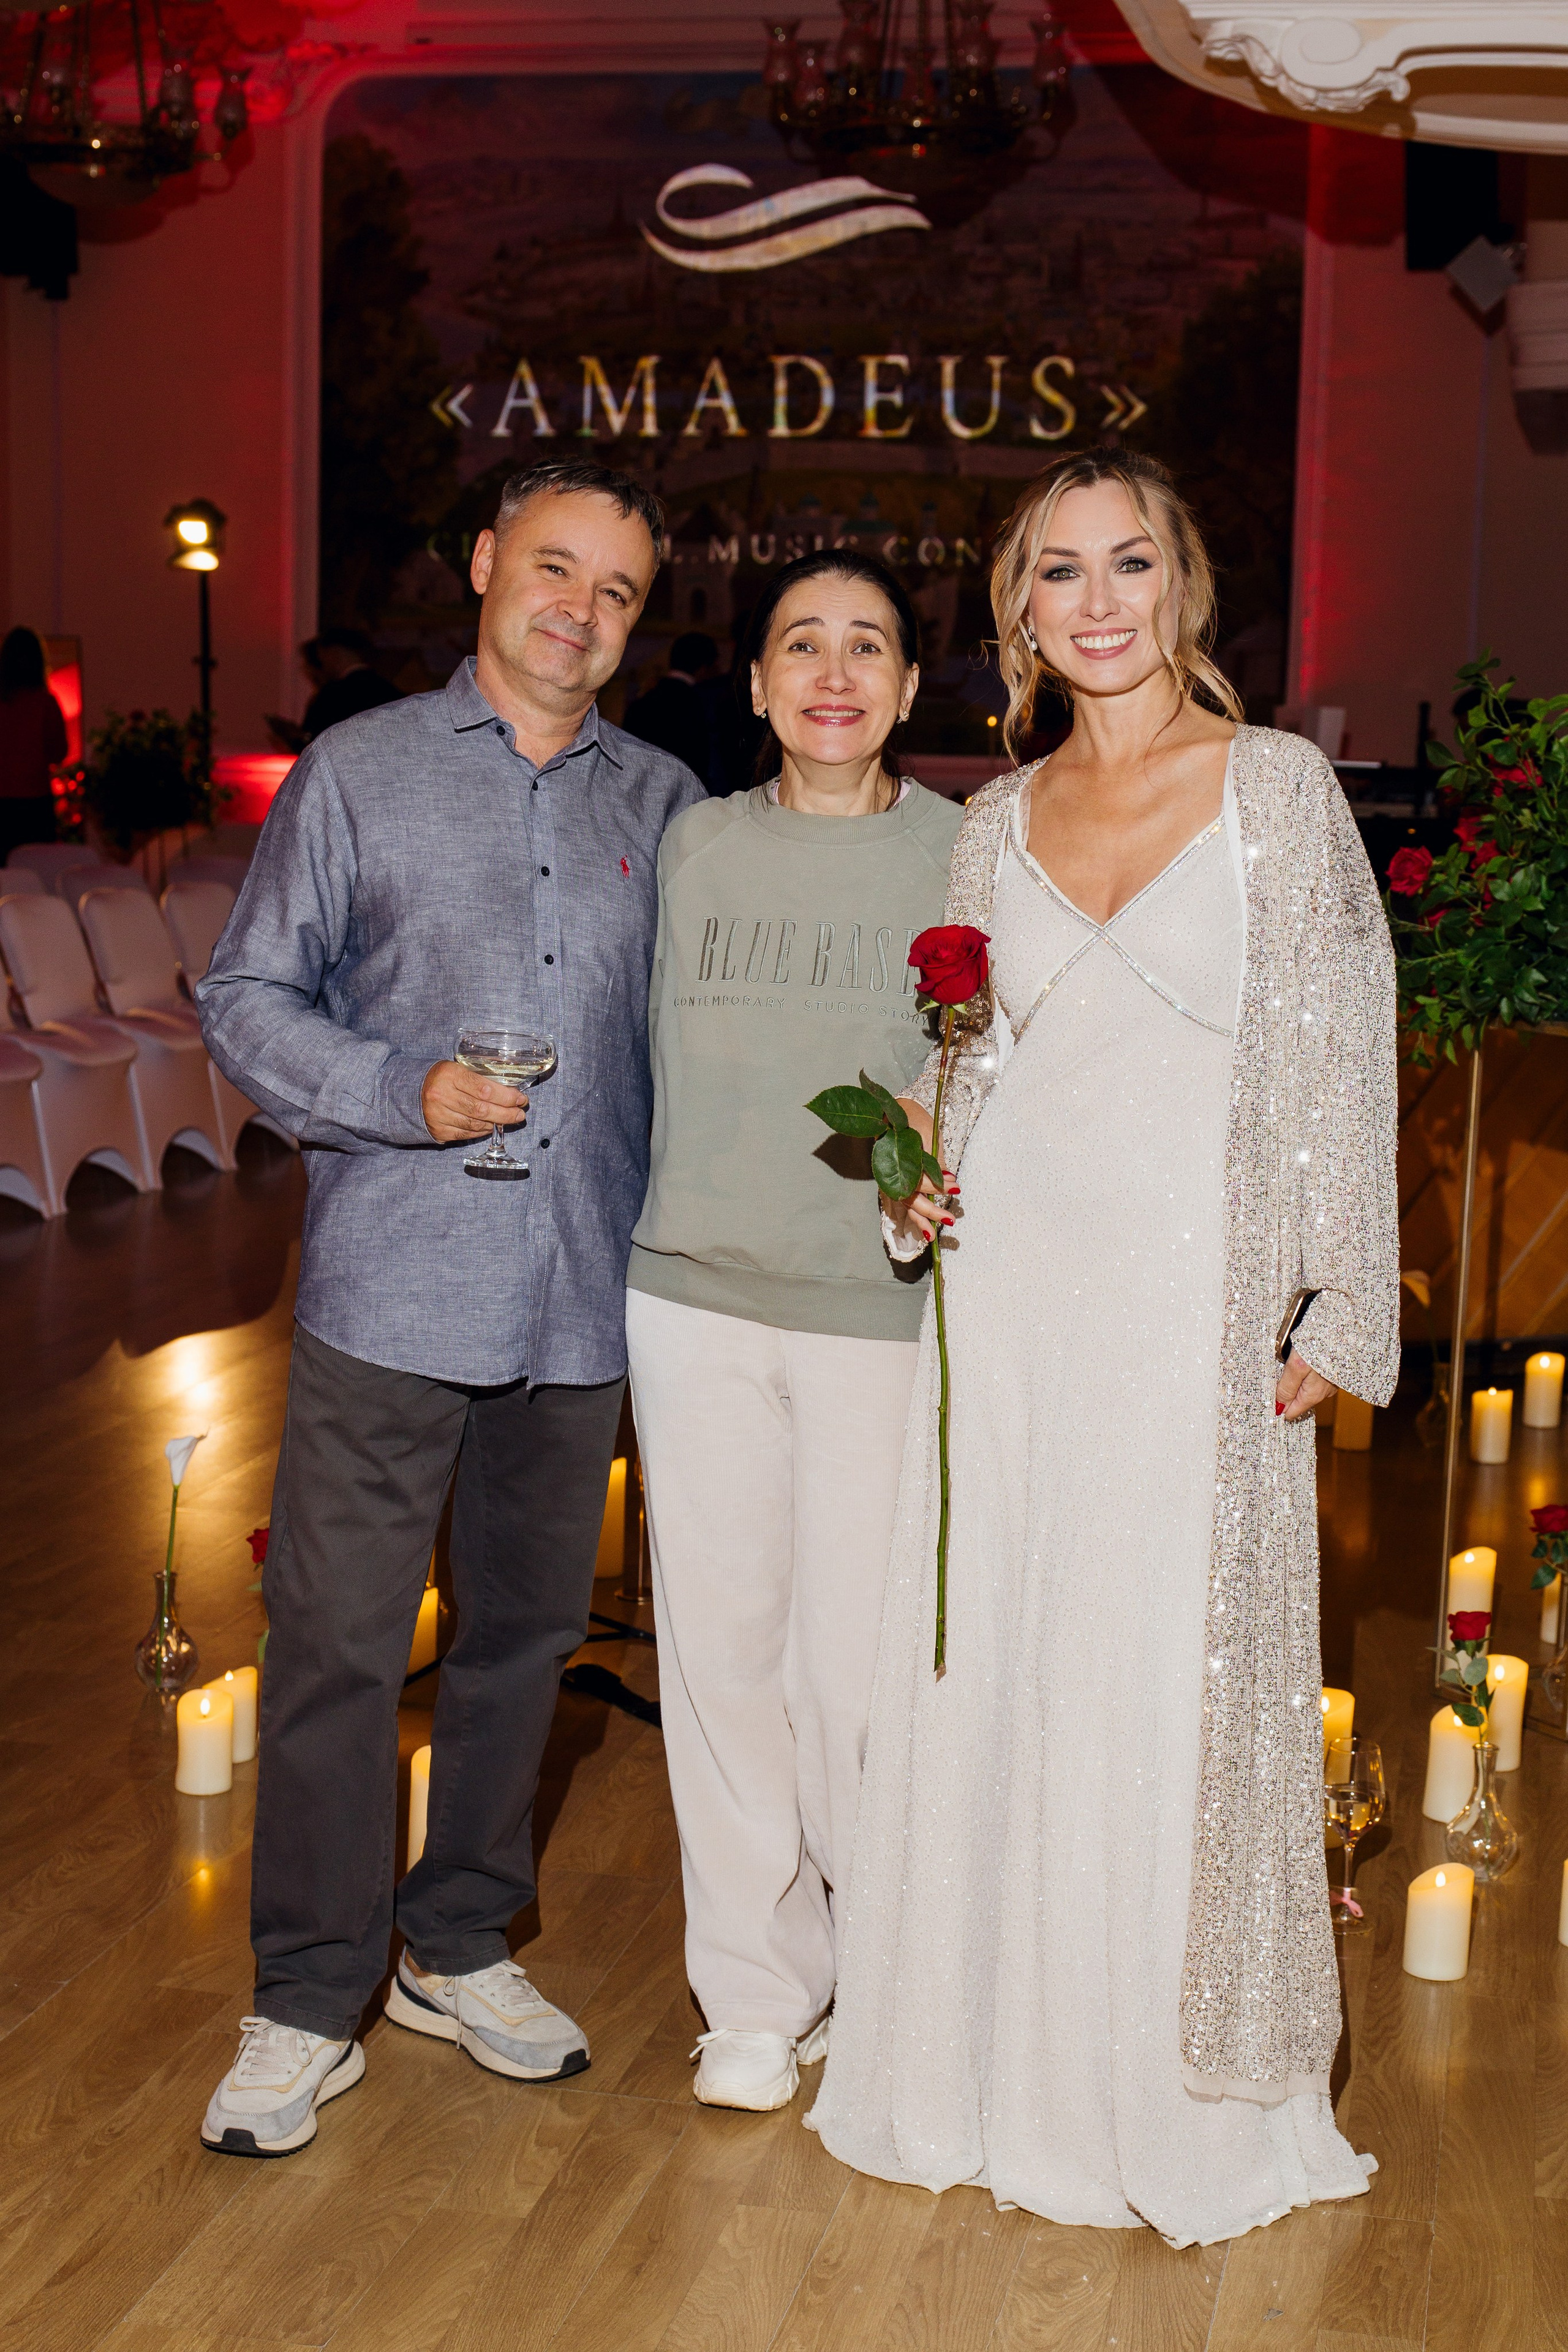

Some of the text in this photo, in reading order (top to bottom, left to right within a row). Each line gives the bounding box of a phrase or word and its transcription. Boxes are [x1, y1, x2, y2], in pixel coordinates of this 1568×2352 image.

[881, 536, 1002, 567] CON
[695, 916, 922, 998] BLUE BASE
[674, 995, 929, 1026] CONTEMPORARY STUDIO STORY
